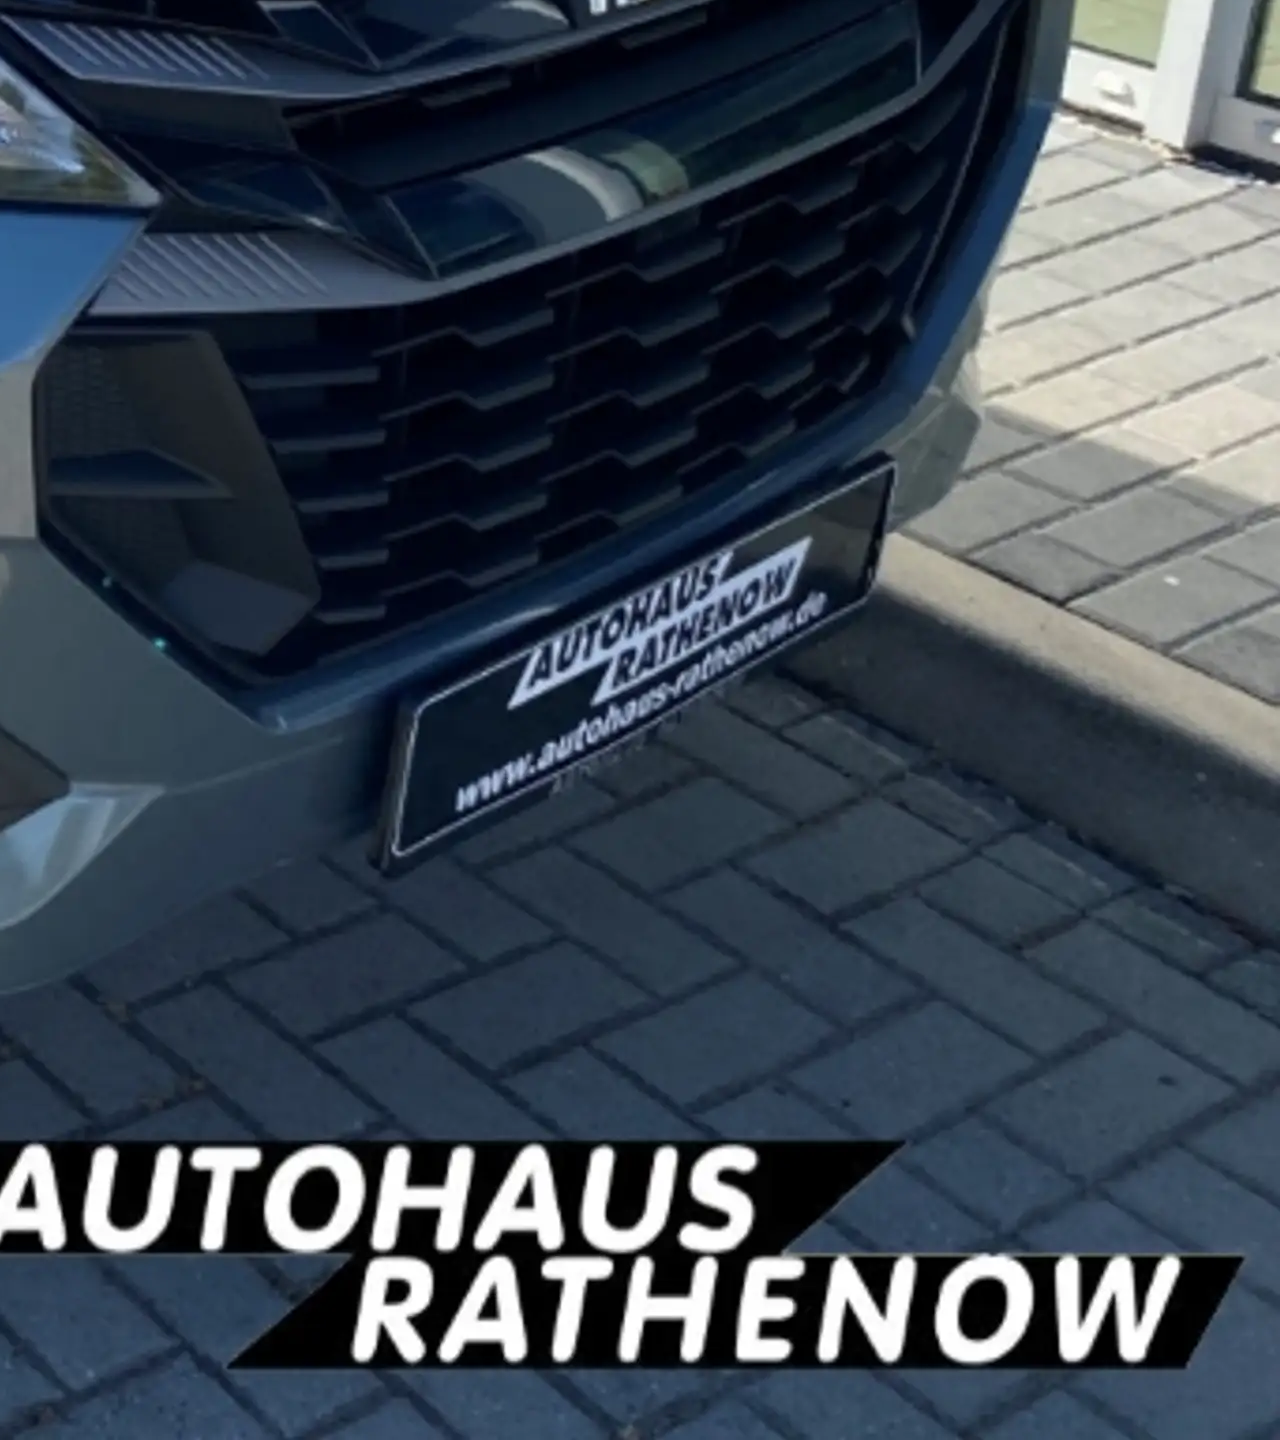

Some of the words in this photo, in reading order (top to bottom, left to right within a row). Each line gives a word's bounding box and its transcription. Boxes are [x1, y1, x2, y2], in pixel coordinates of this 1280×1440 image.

[527, 552, 728, 689] AUTOHAUS
[610, 557, 798, 690] RATHENOW
[454, 591, 827, 812] www.autohaus-rathenow.de
